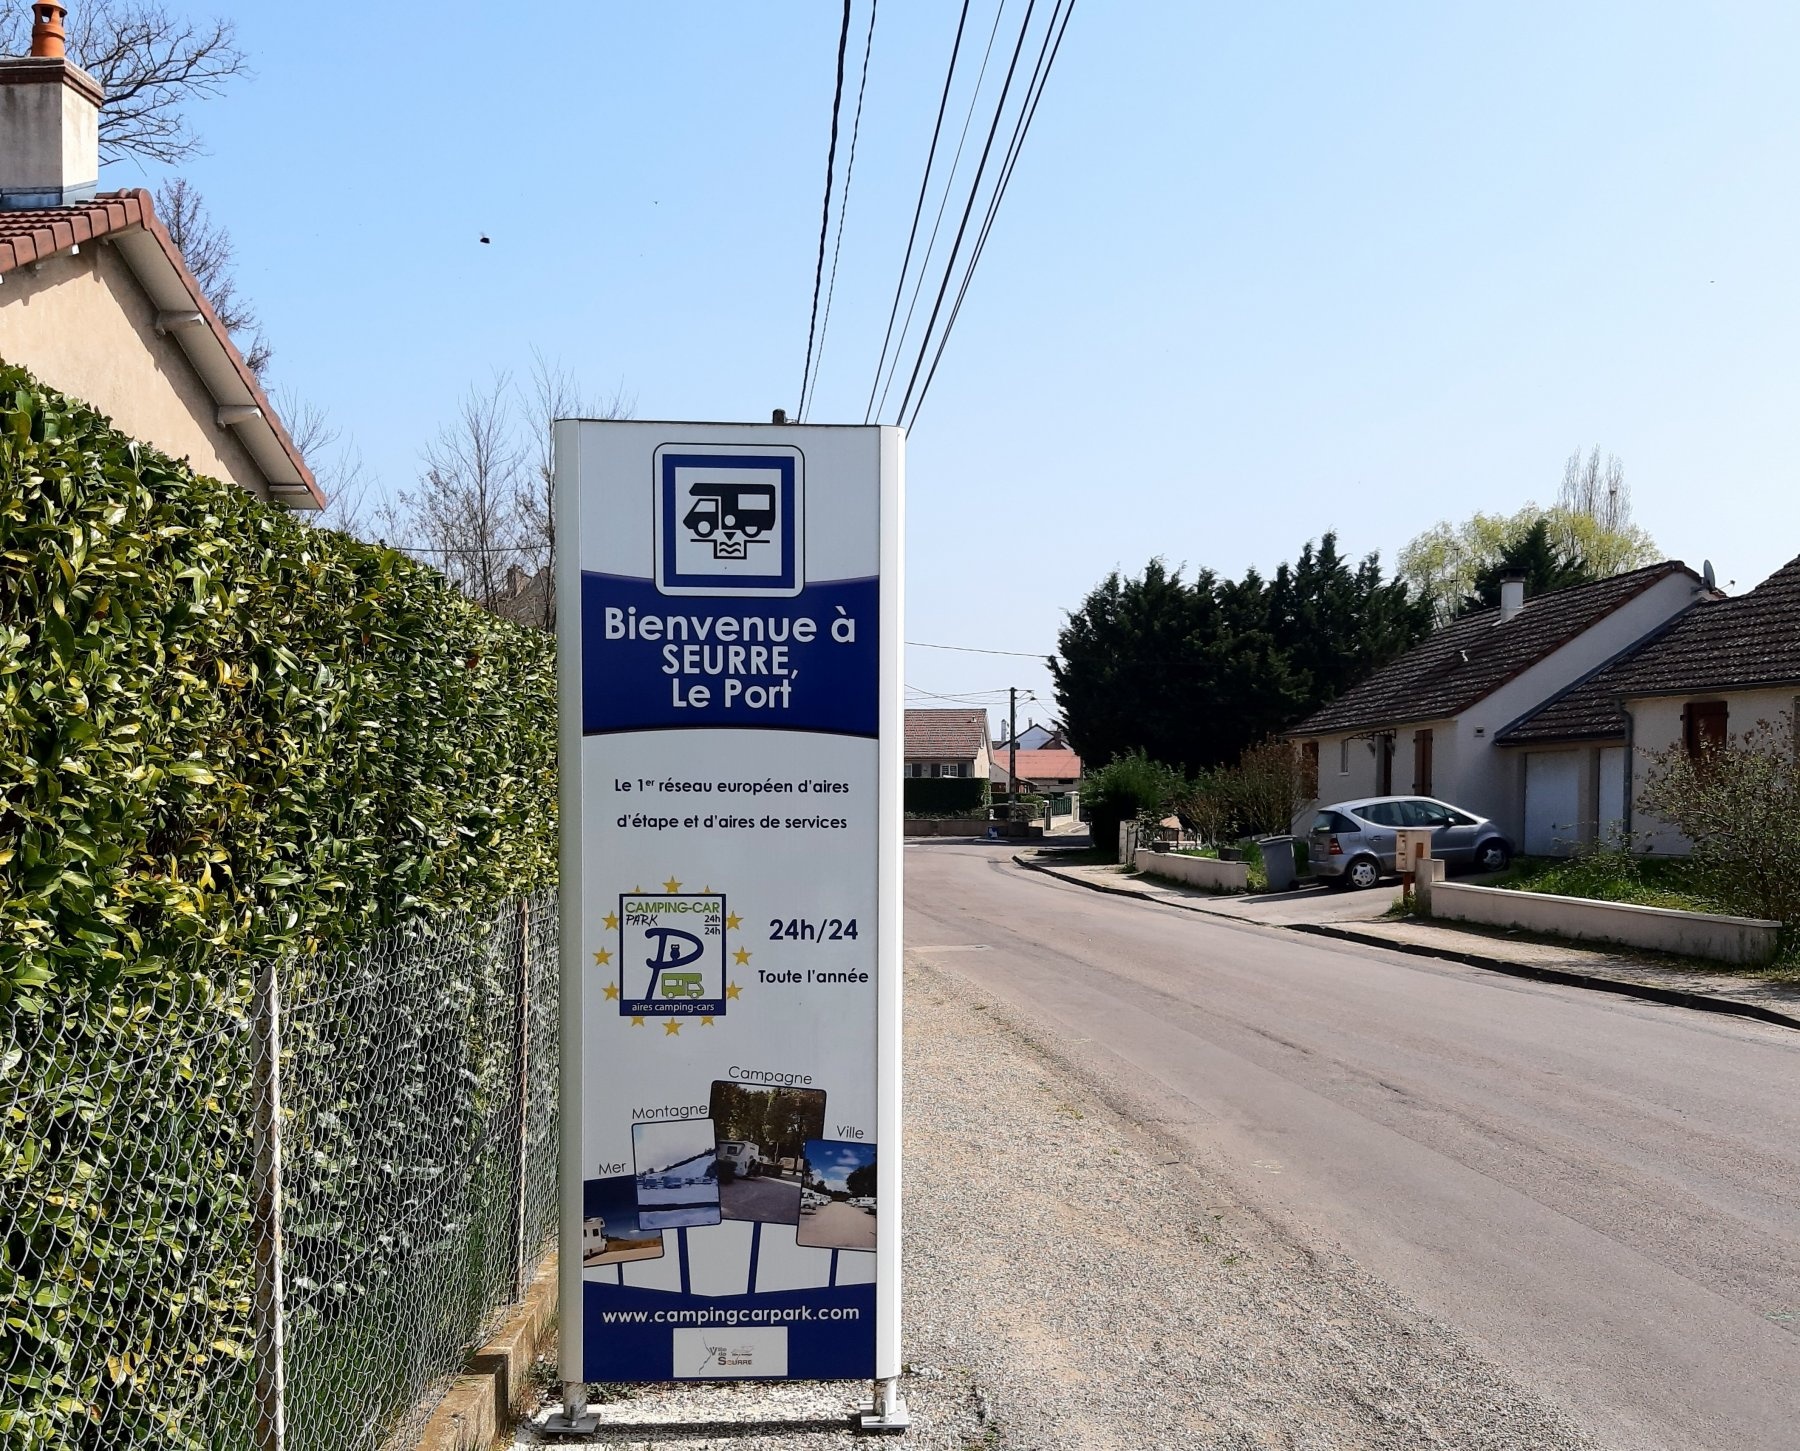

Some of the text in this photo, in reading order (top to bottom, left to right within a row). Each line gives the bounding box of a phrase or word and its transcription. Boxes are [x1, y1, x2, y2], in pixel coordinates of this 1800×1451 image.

[605, 605, 856, 643] Bienvenue à
[662, 644, 799, 680] SEURRE,
[672, 678, 792, 709] Le Port
[614, 779, 632, 792] Le
[658, 778, 712, 793] réseau
[717, 778, 793, 796] européen
[797, 780, 849, 793] d'aires
[616, 813, 847, 831] d'étape et d'aires de services
[625, 902, 720, 914] CAMPING-CAR
[625, 914, 658, 927] PARK
[704, 914, 721, 923] 24h
[704, 926, 721, 935] 24h
[769, 919, 858, 943] 24h/24
[758, 968, 869, 984] Toute l'année
[631, 1003, 715, 1013] aires camping-cars
[728, 1066, 813, 1085] Campagne
[631, 1104, 708, 1120] Montagne
[836, 1126, 864, 1139] Ville
[598, 1162, 626, 1176] Mer
[602, 1306, 860, 1325] www.campingcarpark.com
